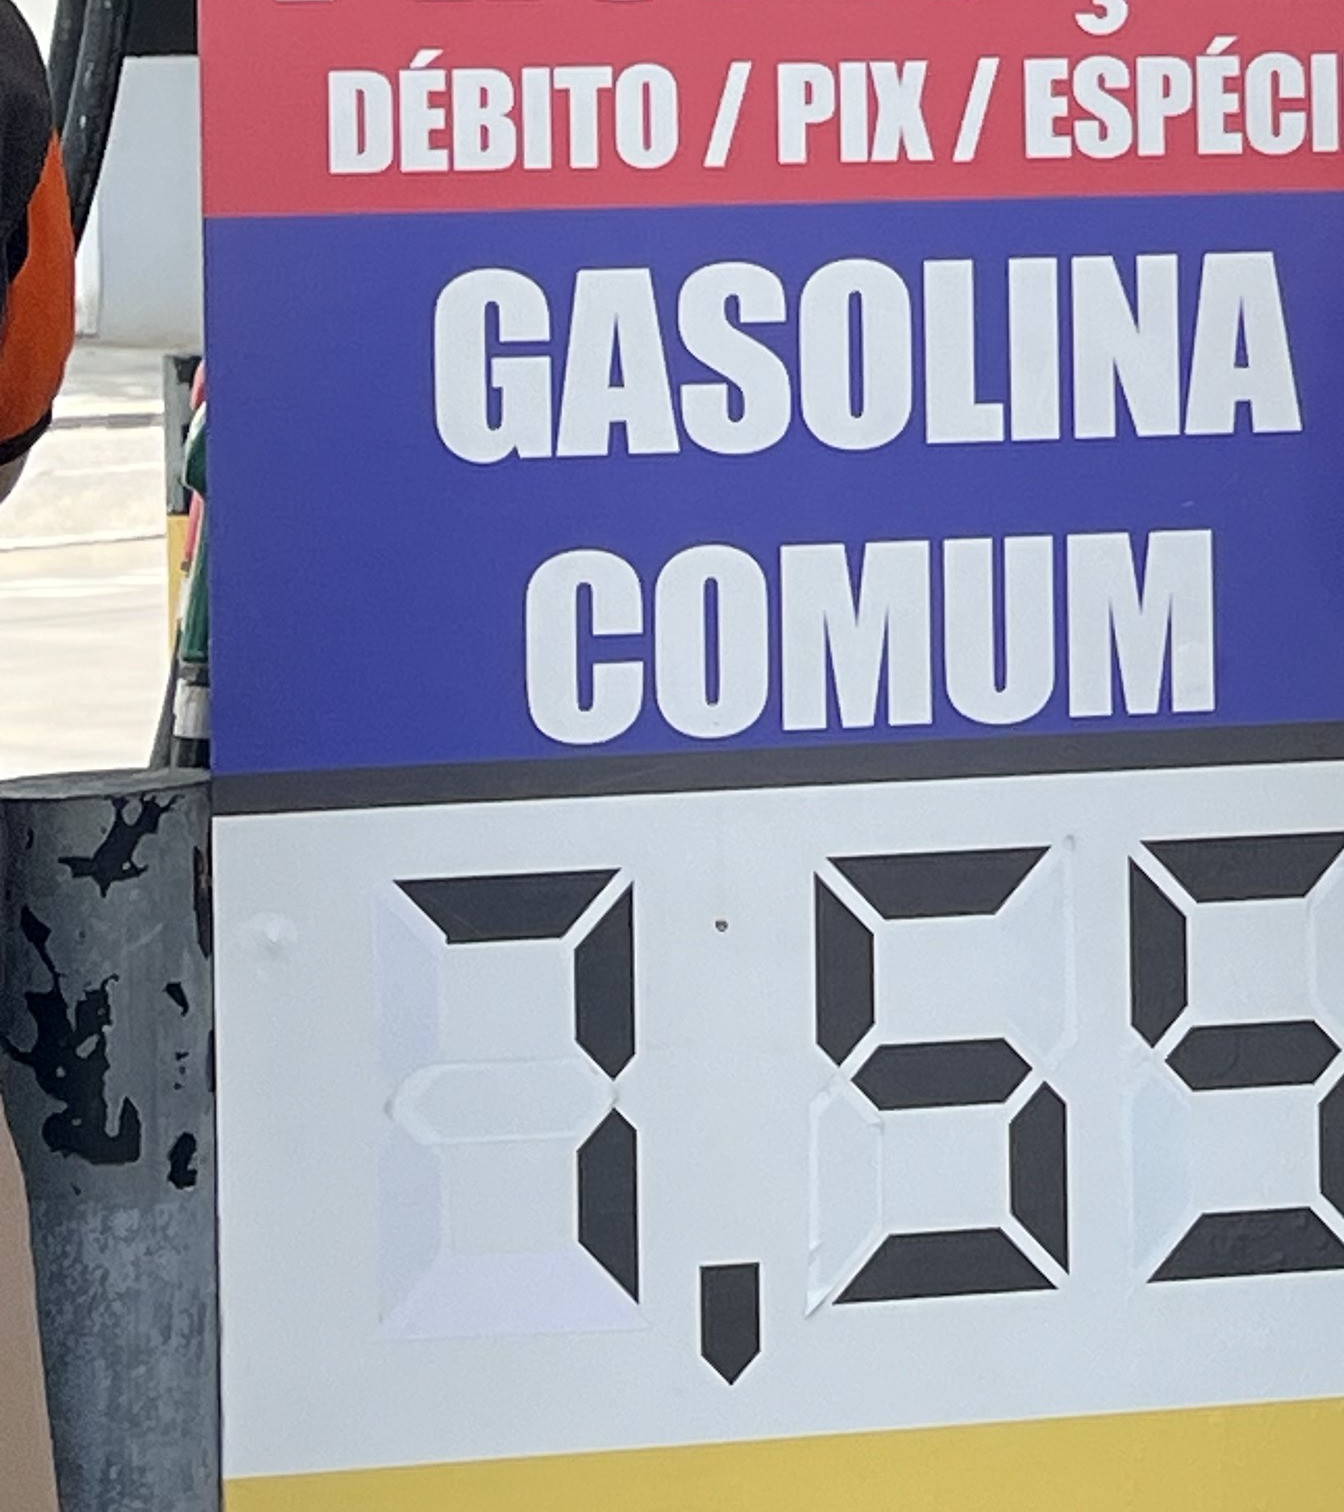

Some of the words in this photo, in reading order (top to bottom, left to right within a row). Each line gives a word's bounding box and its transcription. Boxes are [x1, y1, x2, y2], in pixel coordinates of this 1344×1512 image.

[328, 49, 679, 174] DÉBITO
[703, 61, 752, 168] /
[777, 60, 934, 165] PIX
[952, 57, 1000, 163] /
[434, 251, 1303, 463] GASOLINA
[525, 529, 1215, 744] COMUM
